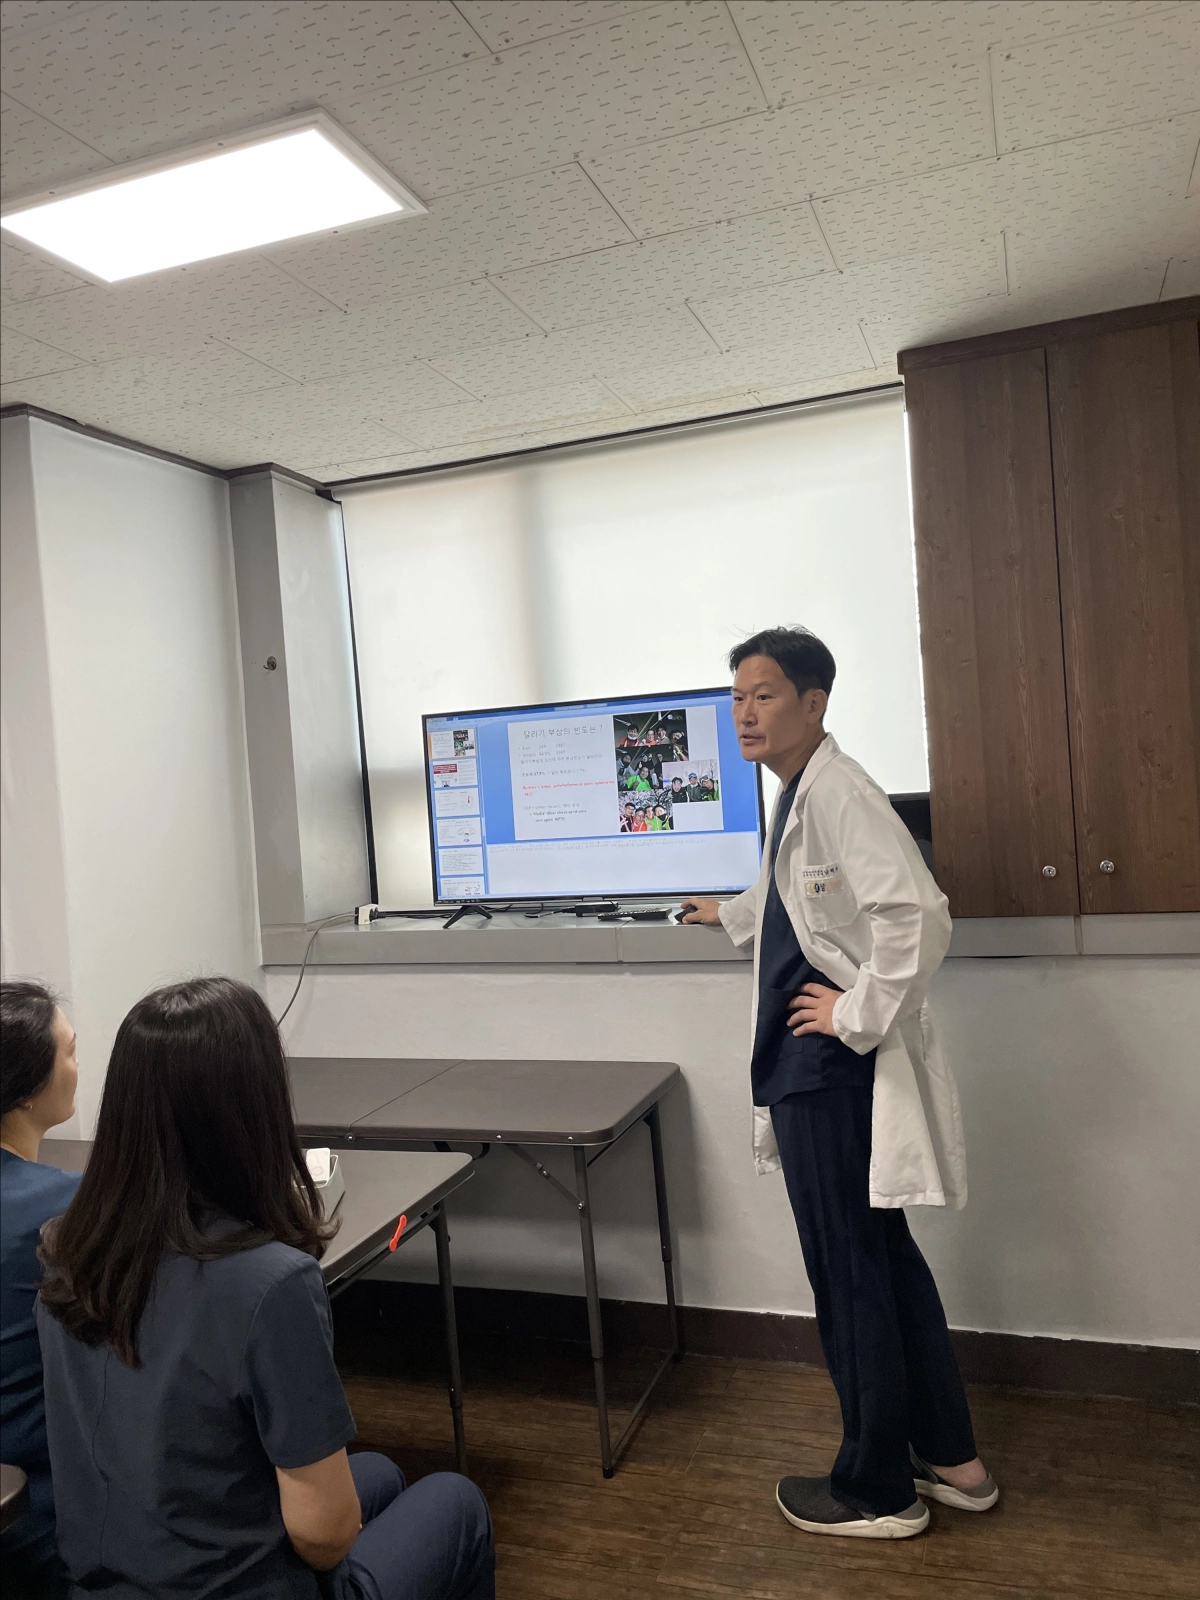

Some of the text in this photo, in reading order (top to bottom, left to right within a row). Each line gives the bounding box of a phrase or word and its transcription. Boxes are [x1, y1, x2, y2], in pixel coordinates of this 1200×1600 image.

[524, 730, 546, 739] 달리기
[548, 728, 570, 737] 부상의
[574, 726, 596, 735] 빈도는
